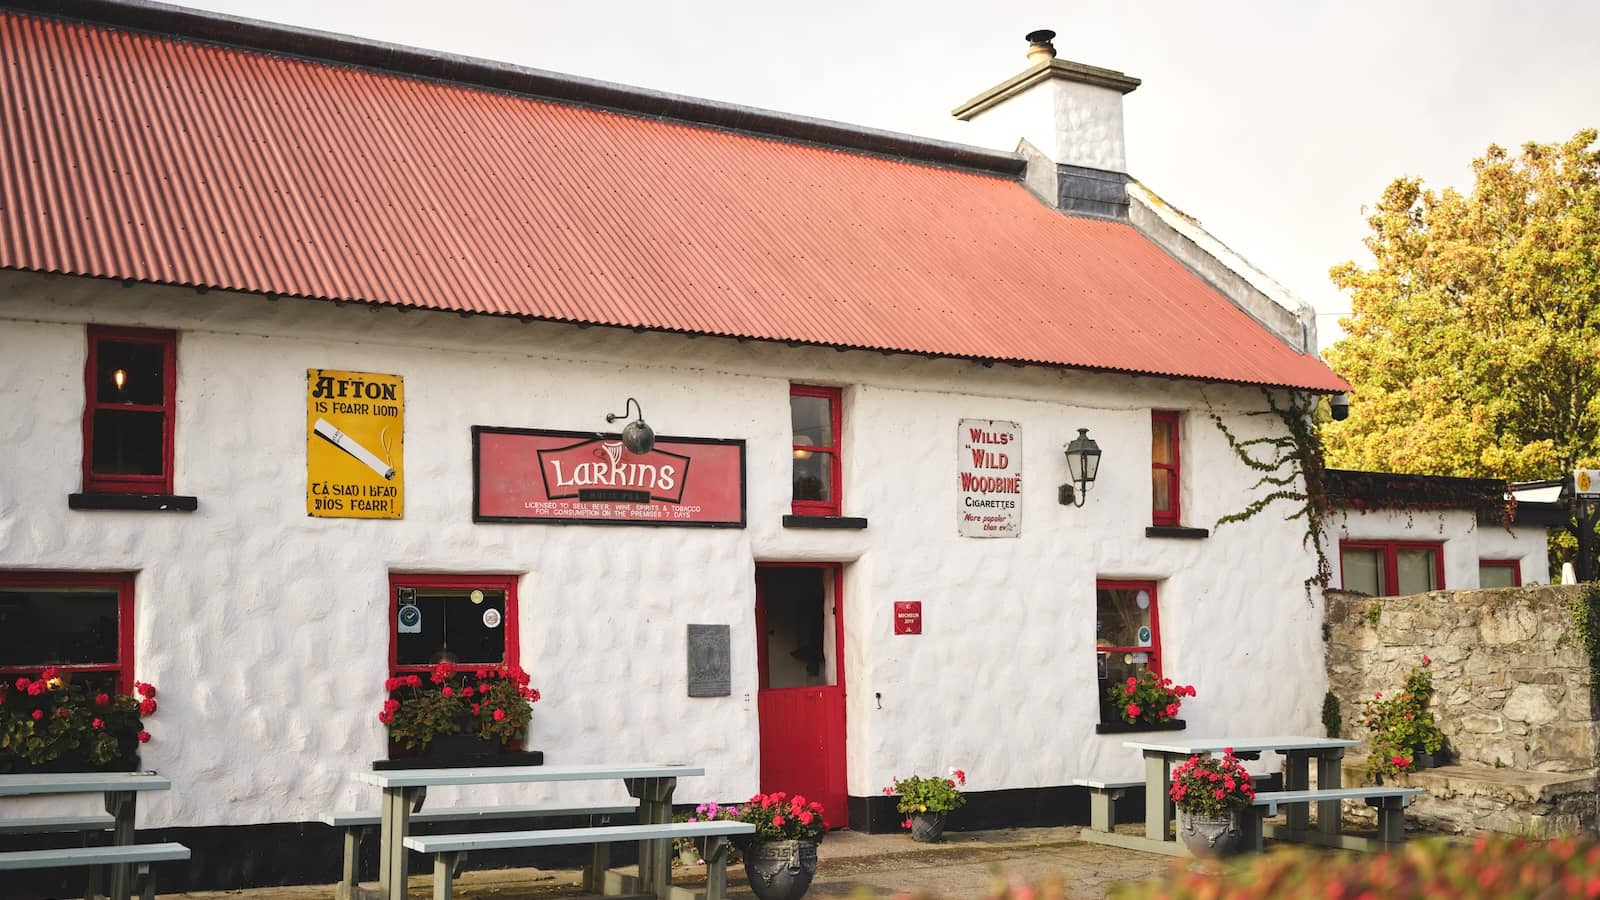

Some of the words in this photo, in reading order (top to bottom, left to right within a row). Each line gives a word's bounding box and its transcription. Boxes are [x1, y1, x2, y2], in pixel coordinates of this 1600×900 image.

[313, 376, 397, 401] AFTON
[315, 401, 328, 413] IS
[333, 402, 369, 415] FEARR
[373, 404, 398, 418] LIOM
[524, 501, 557, 509] LICENSED
